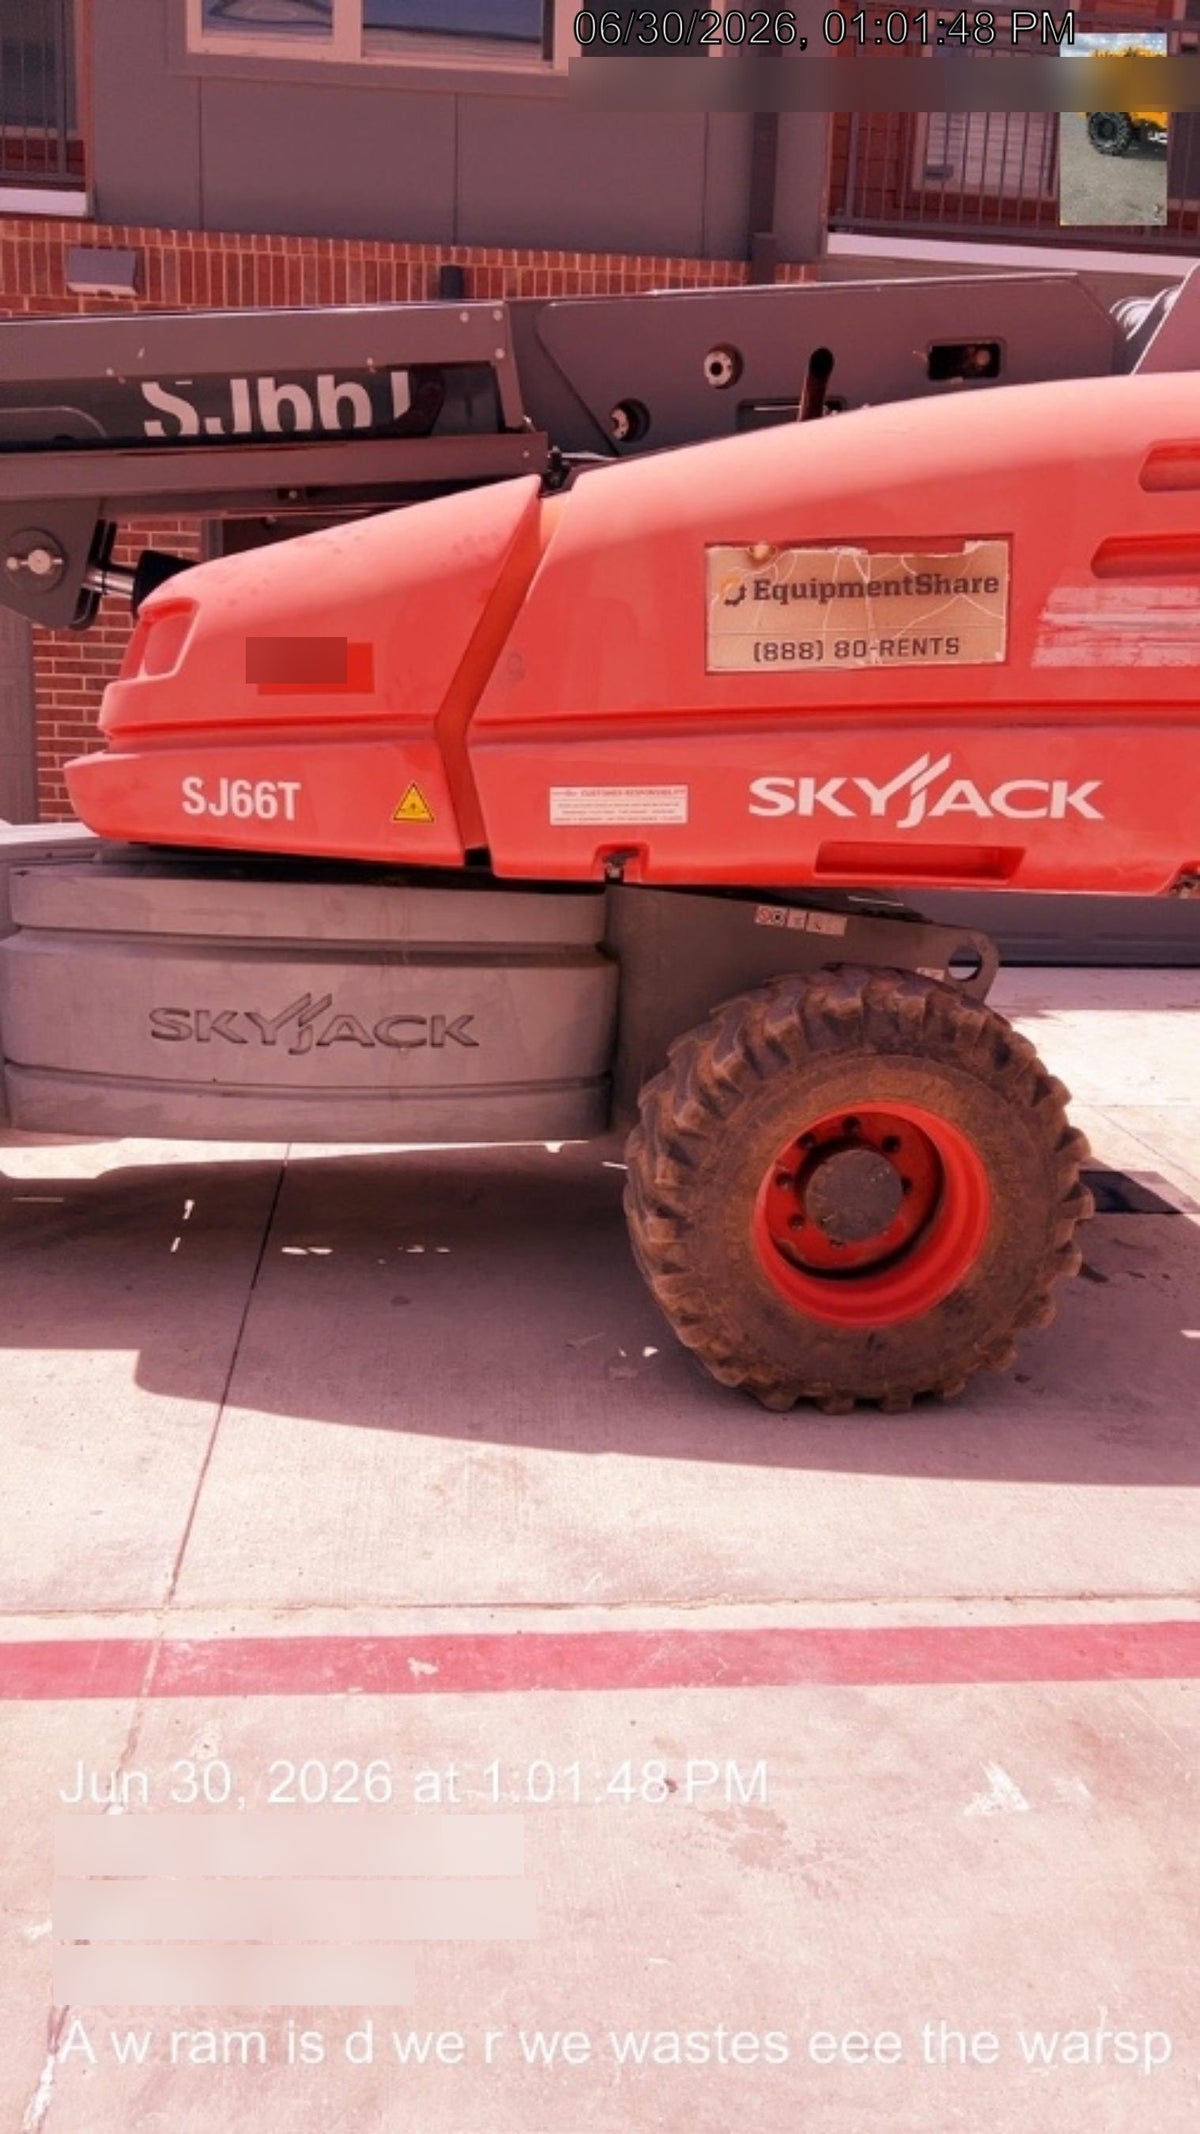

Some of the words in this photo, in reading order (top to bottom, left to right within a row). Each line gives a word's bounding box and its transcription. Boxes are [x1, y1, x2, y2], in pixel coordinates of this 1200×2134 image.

[753, 573, 999, 606] EquipmentShare
[753, 639, 824, 662] (888)
[834, 637, 960, 658] 80-RENTS
[182, 776, 301, 821] SJ66T
[748, 751, 1104, 828] SKYJACK
[149, 992, 480, 1056] SKYJACK
